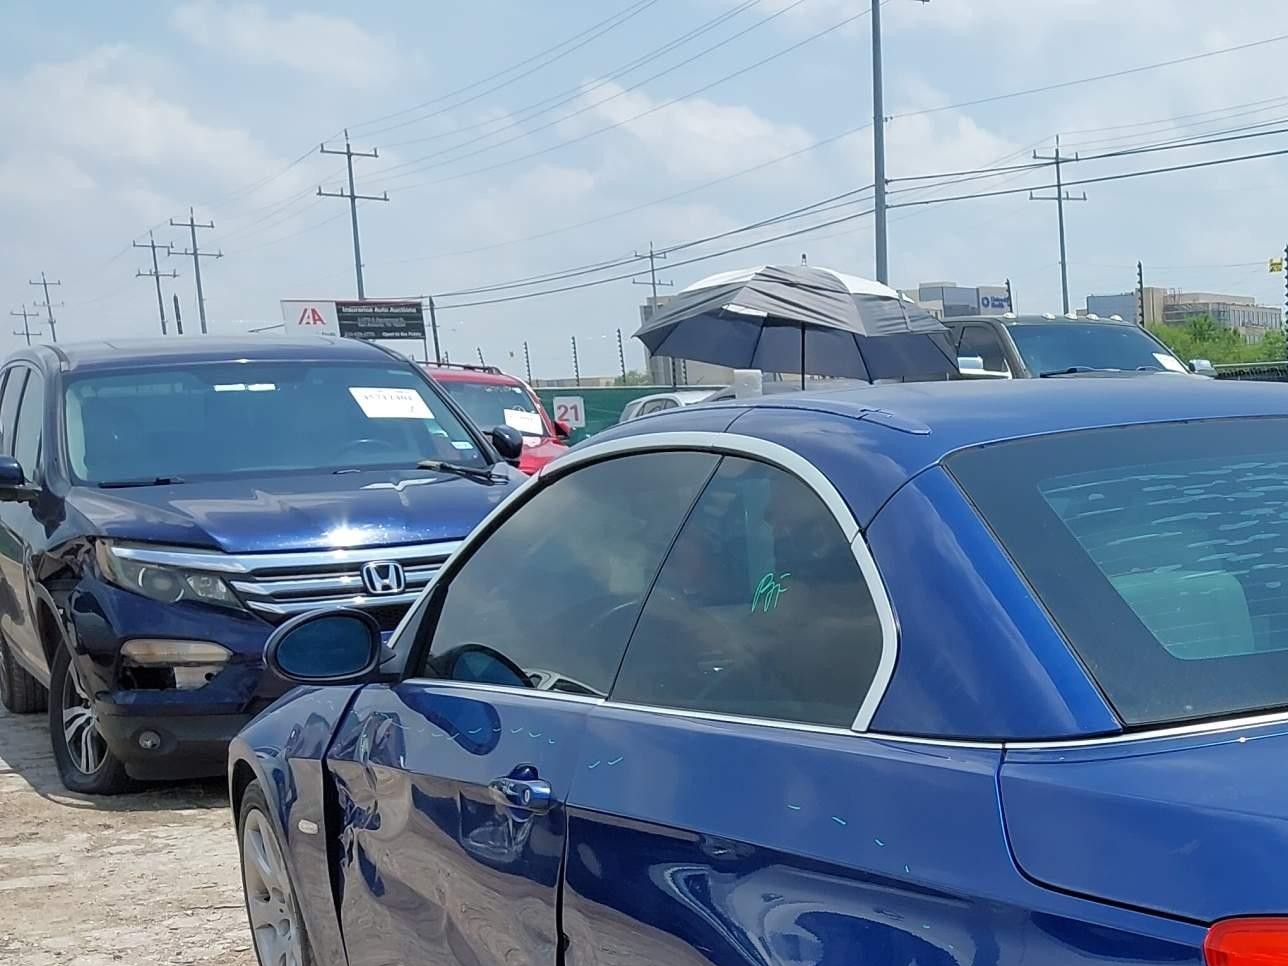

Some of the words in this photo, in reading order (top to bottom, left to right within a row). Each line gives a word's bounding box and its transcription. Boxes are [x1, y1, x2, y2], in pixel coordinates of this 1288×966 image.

[342, 305, 373, 313] Insurance
[374, 305, 389, 313] Auto
[389, 305, 417, 313] Auctions
[557, 404, 580, 422] 21
